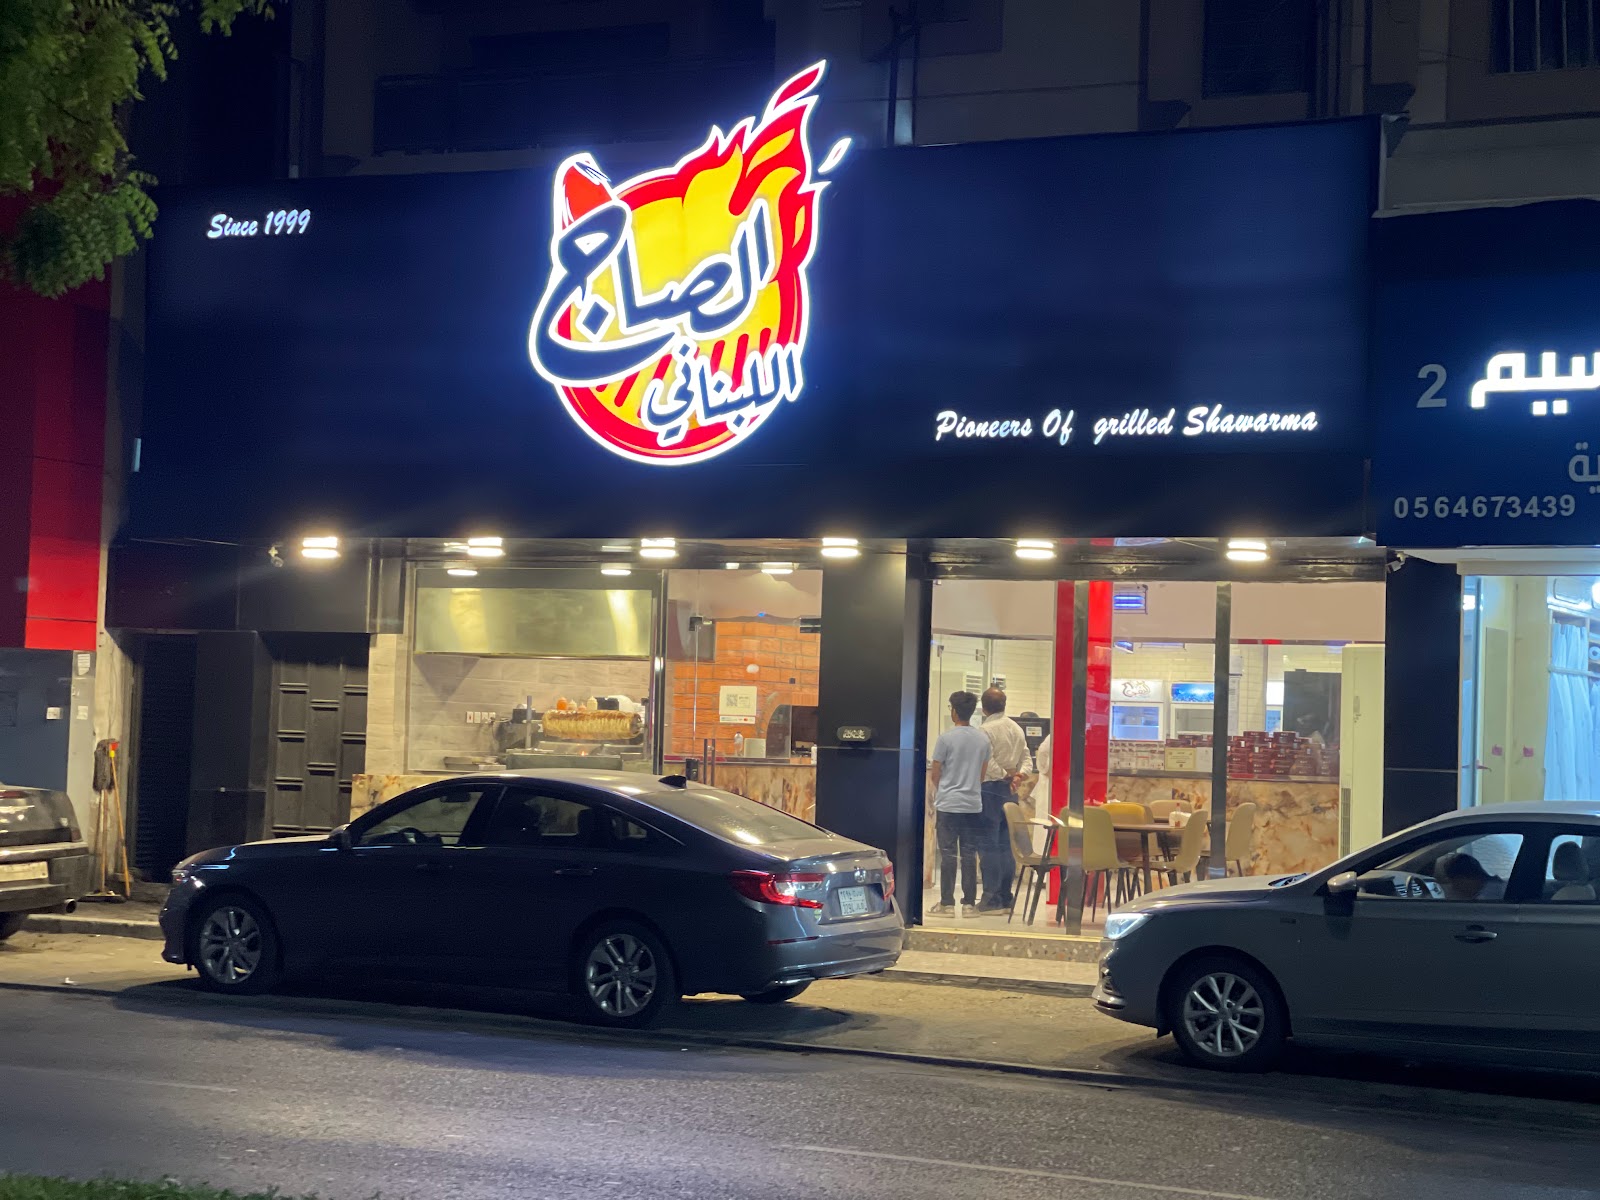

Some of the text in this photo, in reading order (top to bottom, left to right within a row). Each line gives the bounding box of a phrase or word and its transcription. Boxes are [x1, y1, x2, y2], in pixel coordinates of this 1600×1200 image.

[206, 208, 311, 239] Since 1999
[533, 200, 771, 383] الصاج
[645, 341, 799, 443] اللبناني
[1416, 363, 1448, 409] 2
[935, 403, 1319, 446] Pioneers Of grilled Shawarma
[1394, 494, 1576, 519] 0564673439
